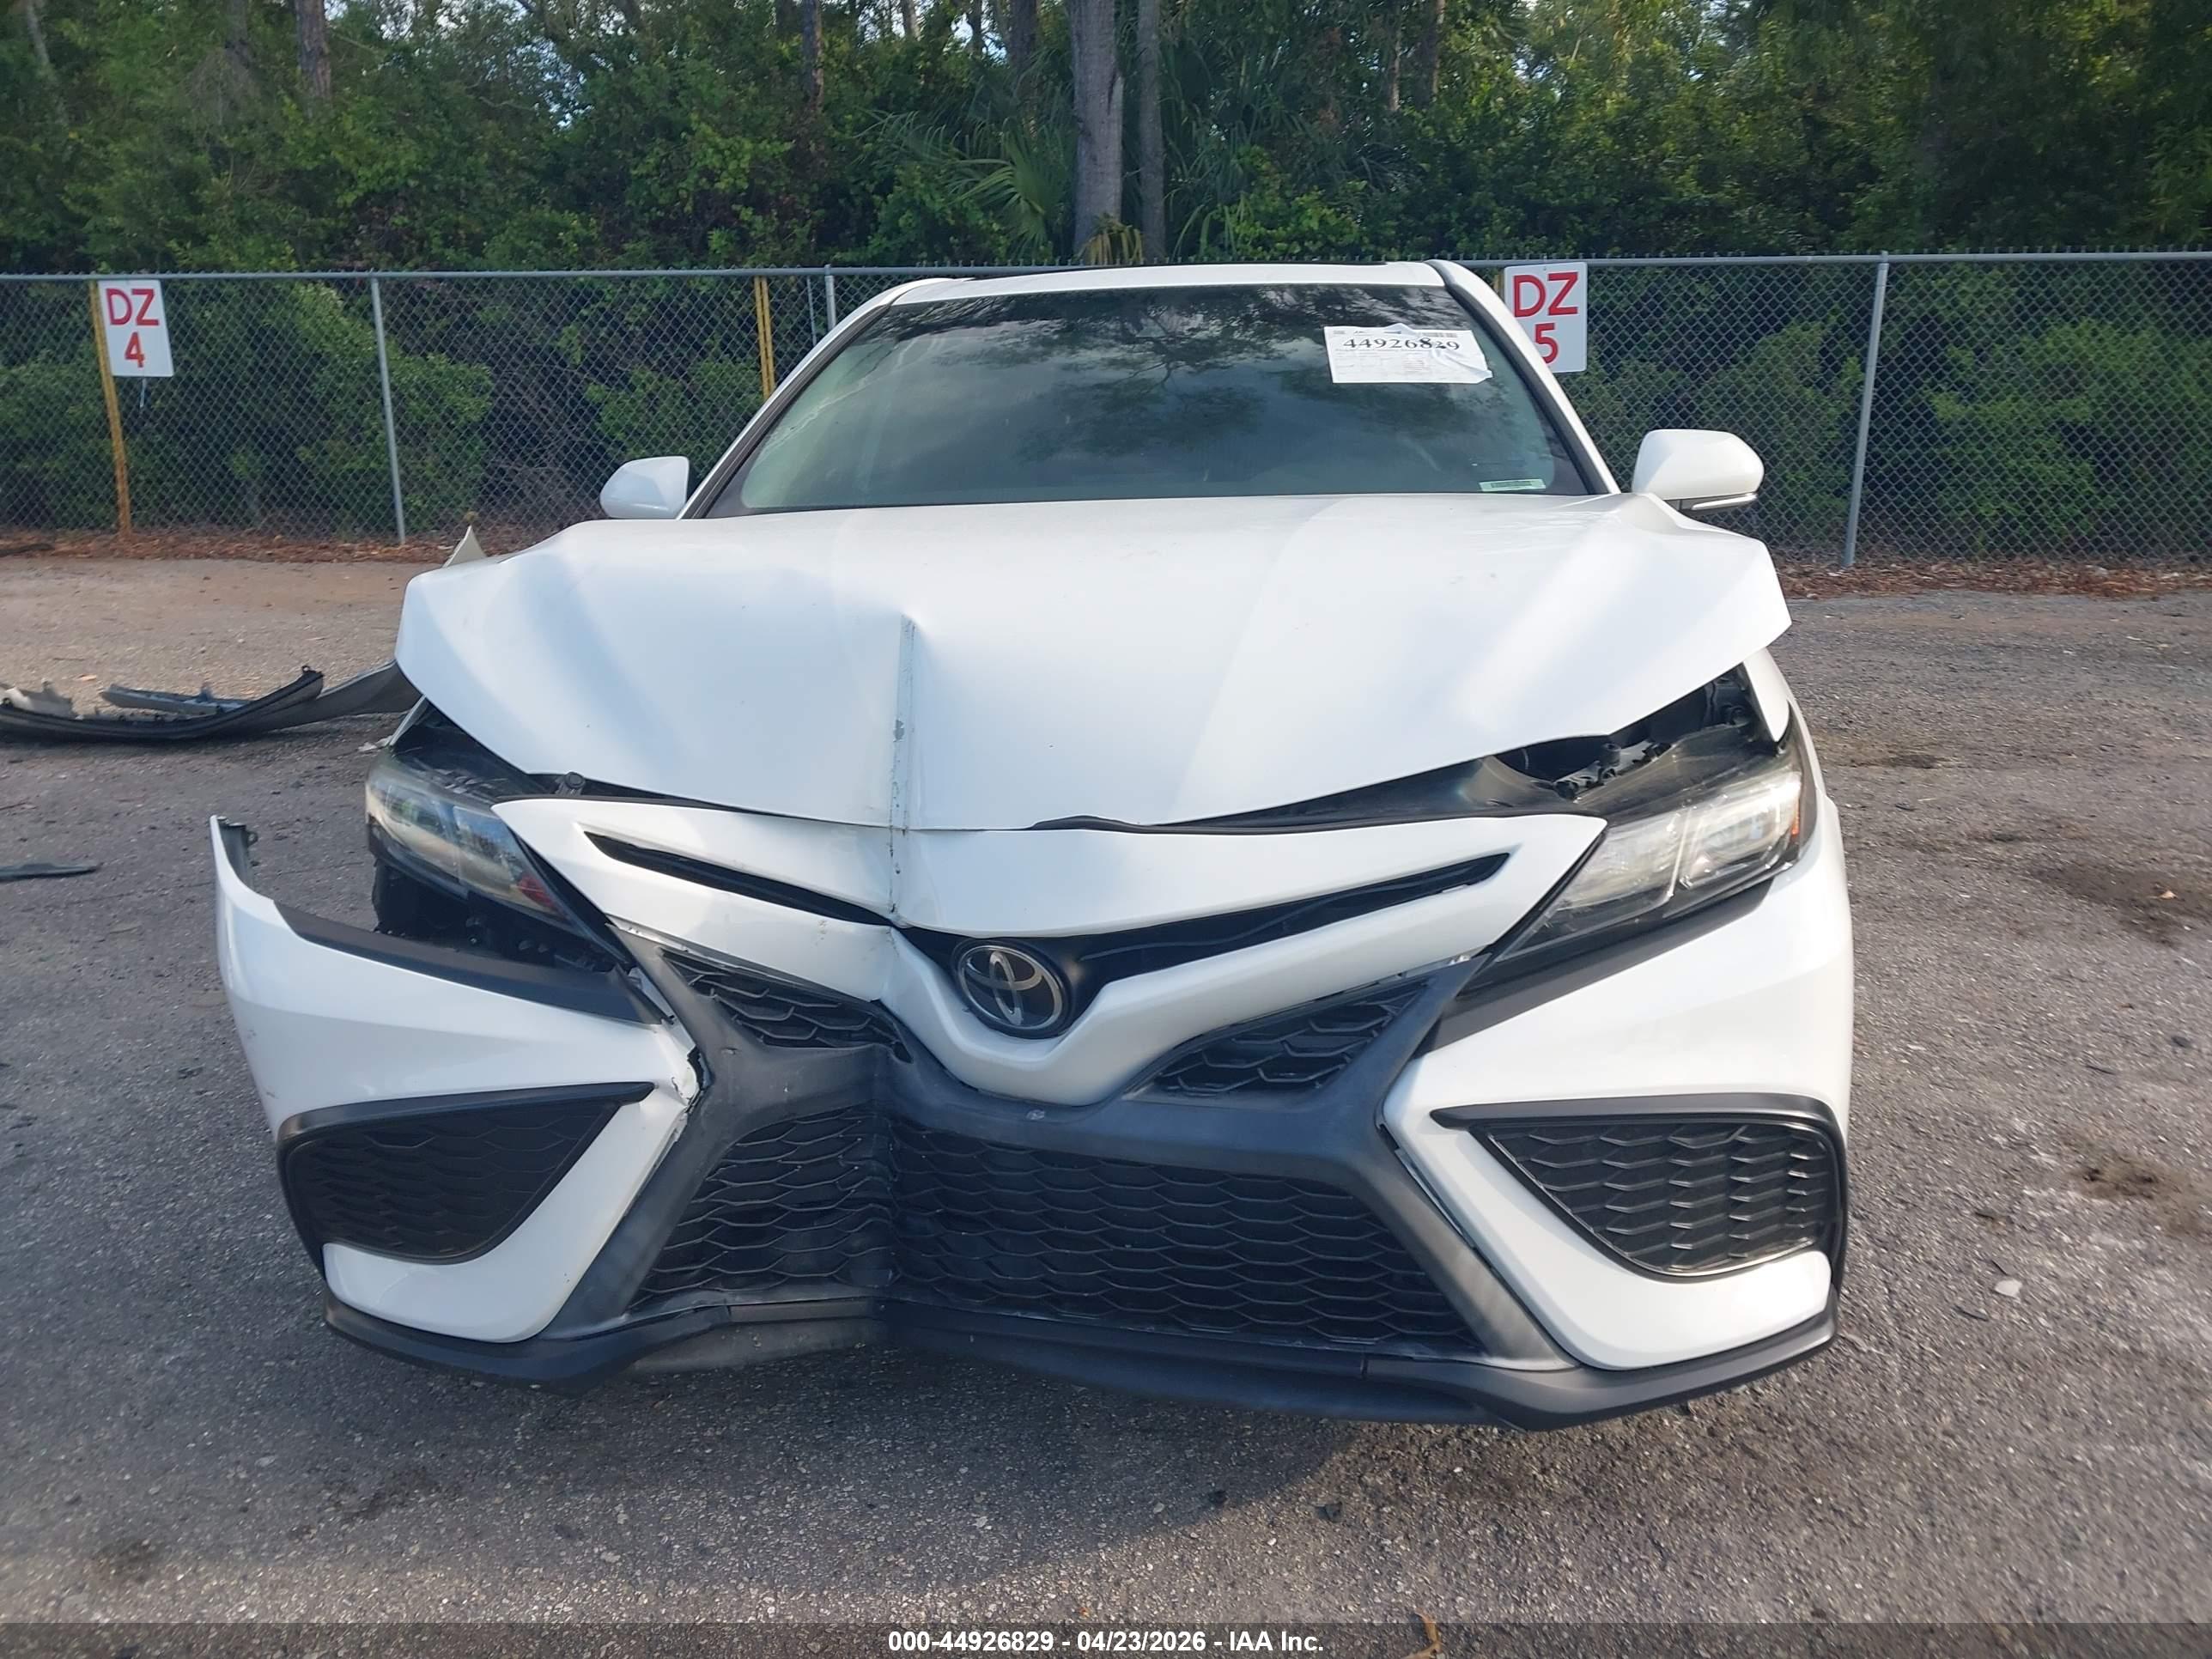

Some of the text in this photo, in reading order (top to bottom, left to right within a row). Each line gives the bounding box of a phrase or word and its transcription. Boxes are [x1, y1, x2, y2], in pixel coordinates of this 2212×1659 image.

[106, 288, 159, 325] DZ
[1513, 271, 1578, 318] DZ
[125, 331, 144, 368] 4
[1534, 322, 1559, 364] 5
